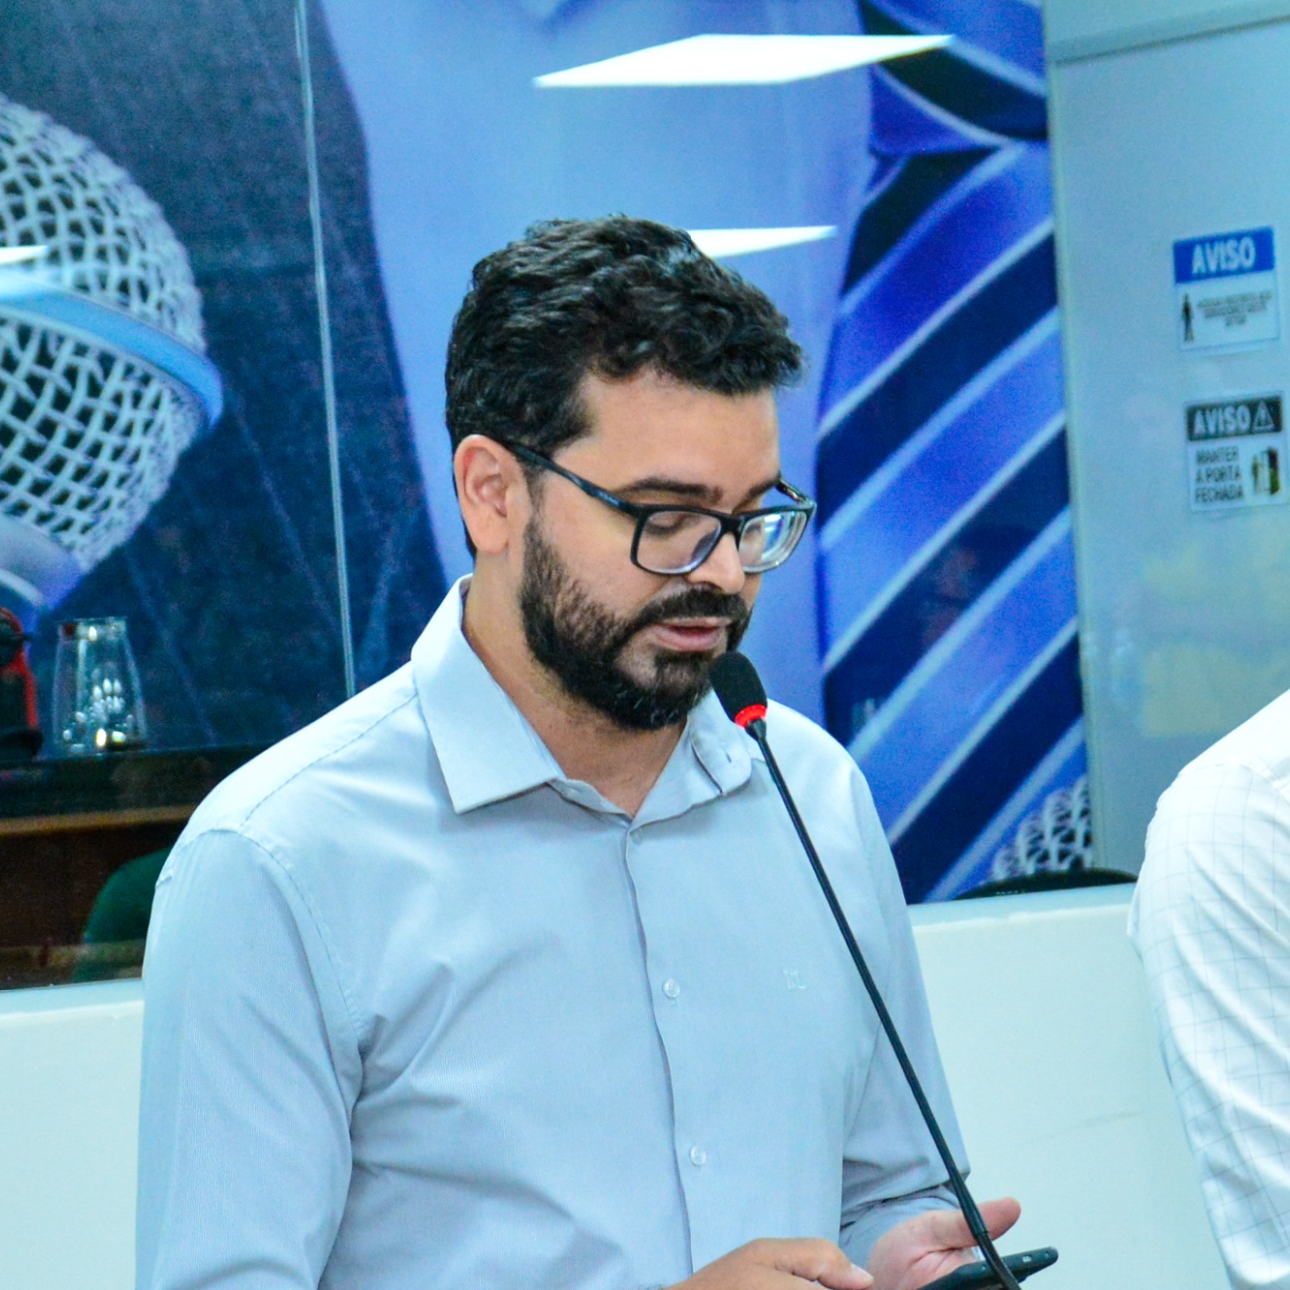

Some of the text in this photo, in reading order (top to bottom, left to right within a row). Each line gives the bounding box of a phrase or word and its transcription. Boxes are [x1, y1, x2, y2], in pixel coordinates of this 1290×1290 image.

[1192, 237, 1256, 274] AVISO
[1194, 405, 1251, 434] AVISO
[1196, 446, 1238, 464] MANTER
